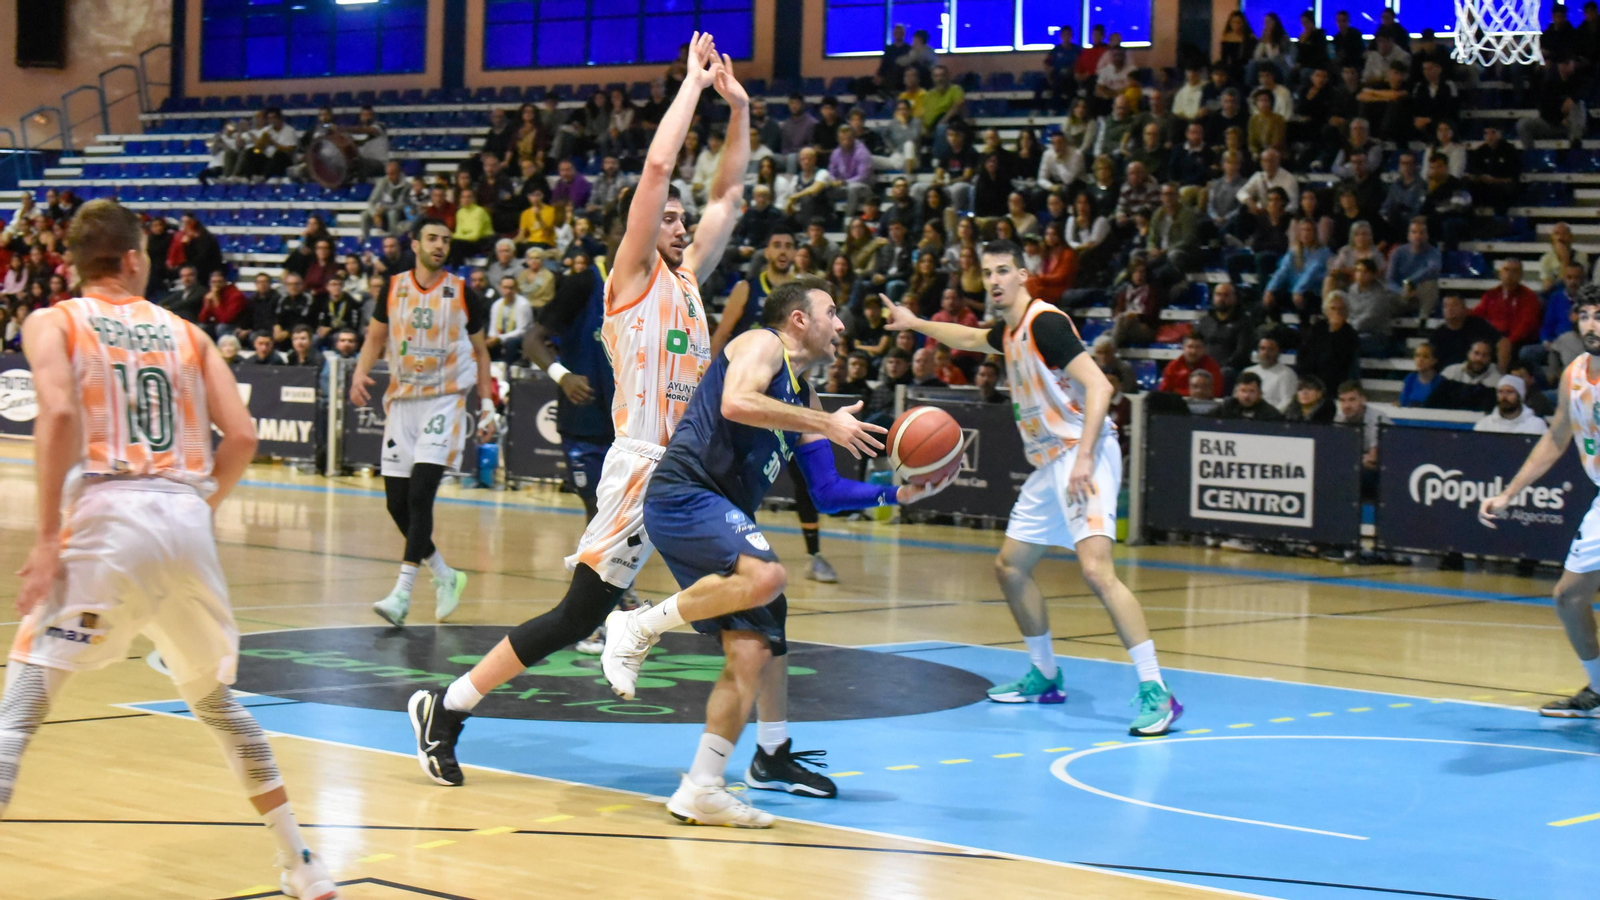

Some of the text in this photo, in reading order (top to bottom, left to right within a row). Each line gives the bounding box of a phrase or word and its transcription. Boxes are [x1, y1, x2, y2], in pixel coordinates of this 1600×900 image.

[412, 307, 433, 329] 33
[668, 382, 697, 394] AYUNT
[112, 363, 173, 451] 10
[424, 414, 445, 434] 33
[1199, 438, 1236, 456] BAR
[1199, 460, 1305, 479] CAFETERÍA
[1202, 488, 1301, 515] CENTRO
[1511, 511, 1564, 526] Algeciras
